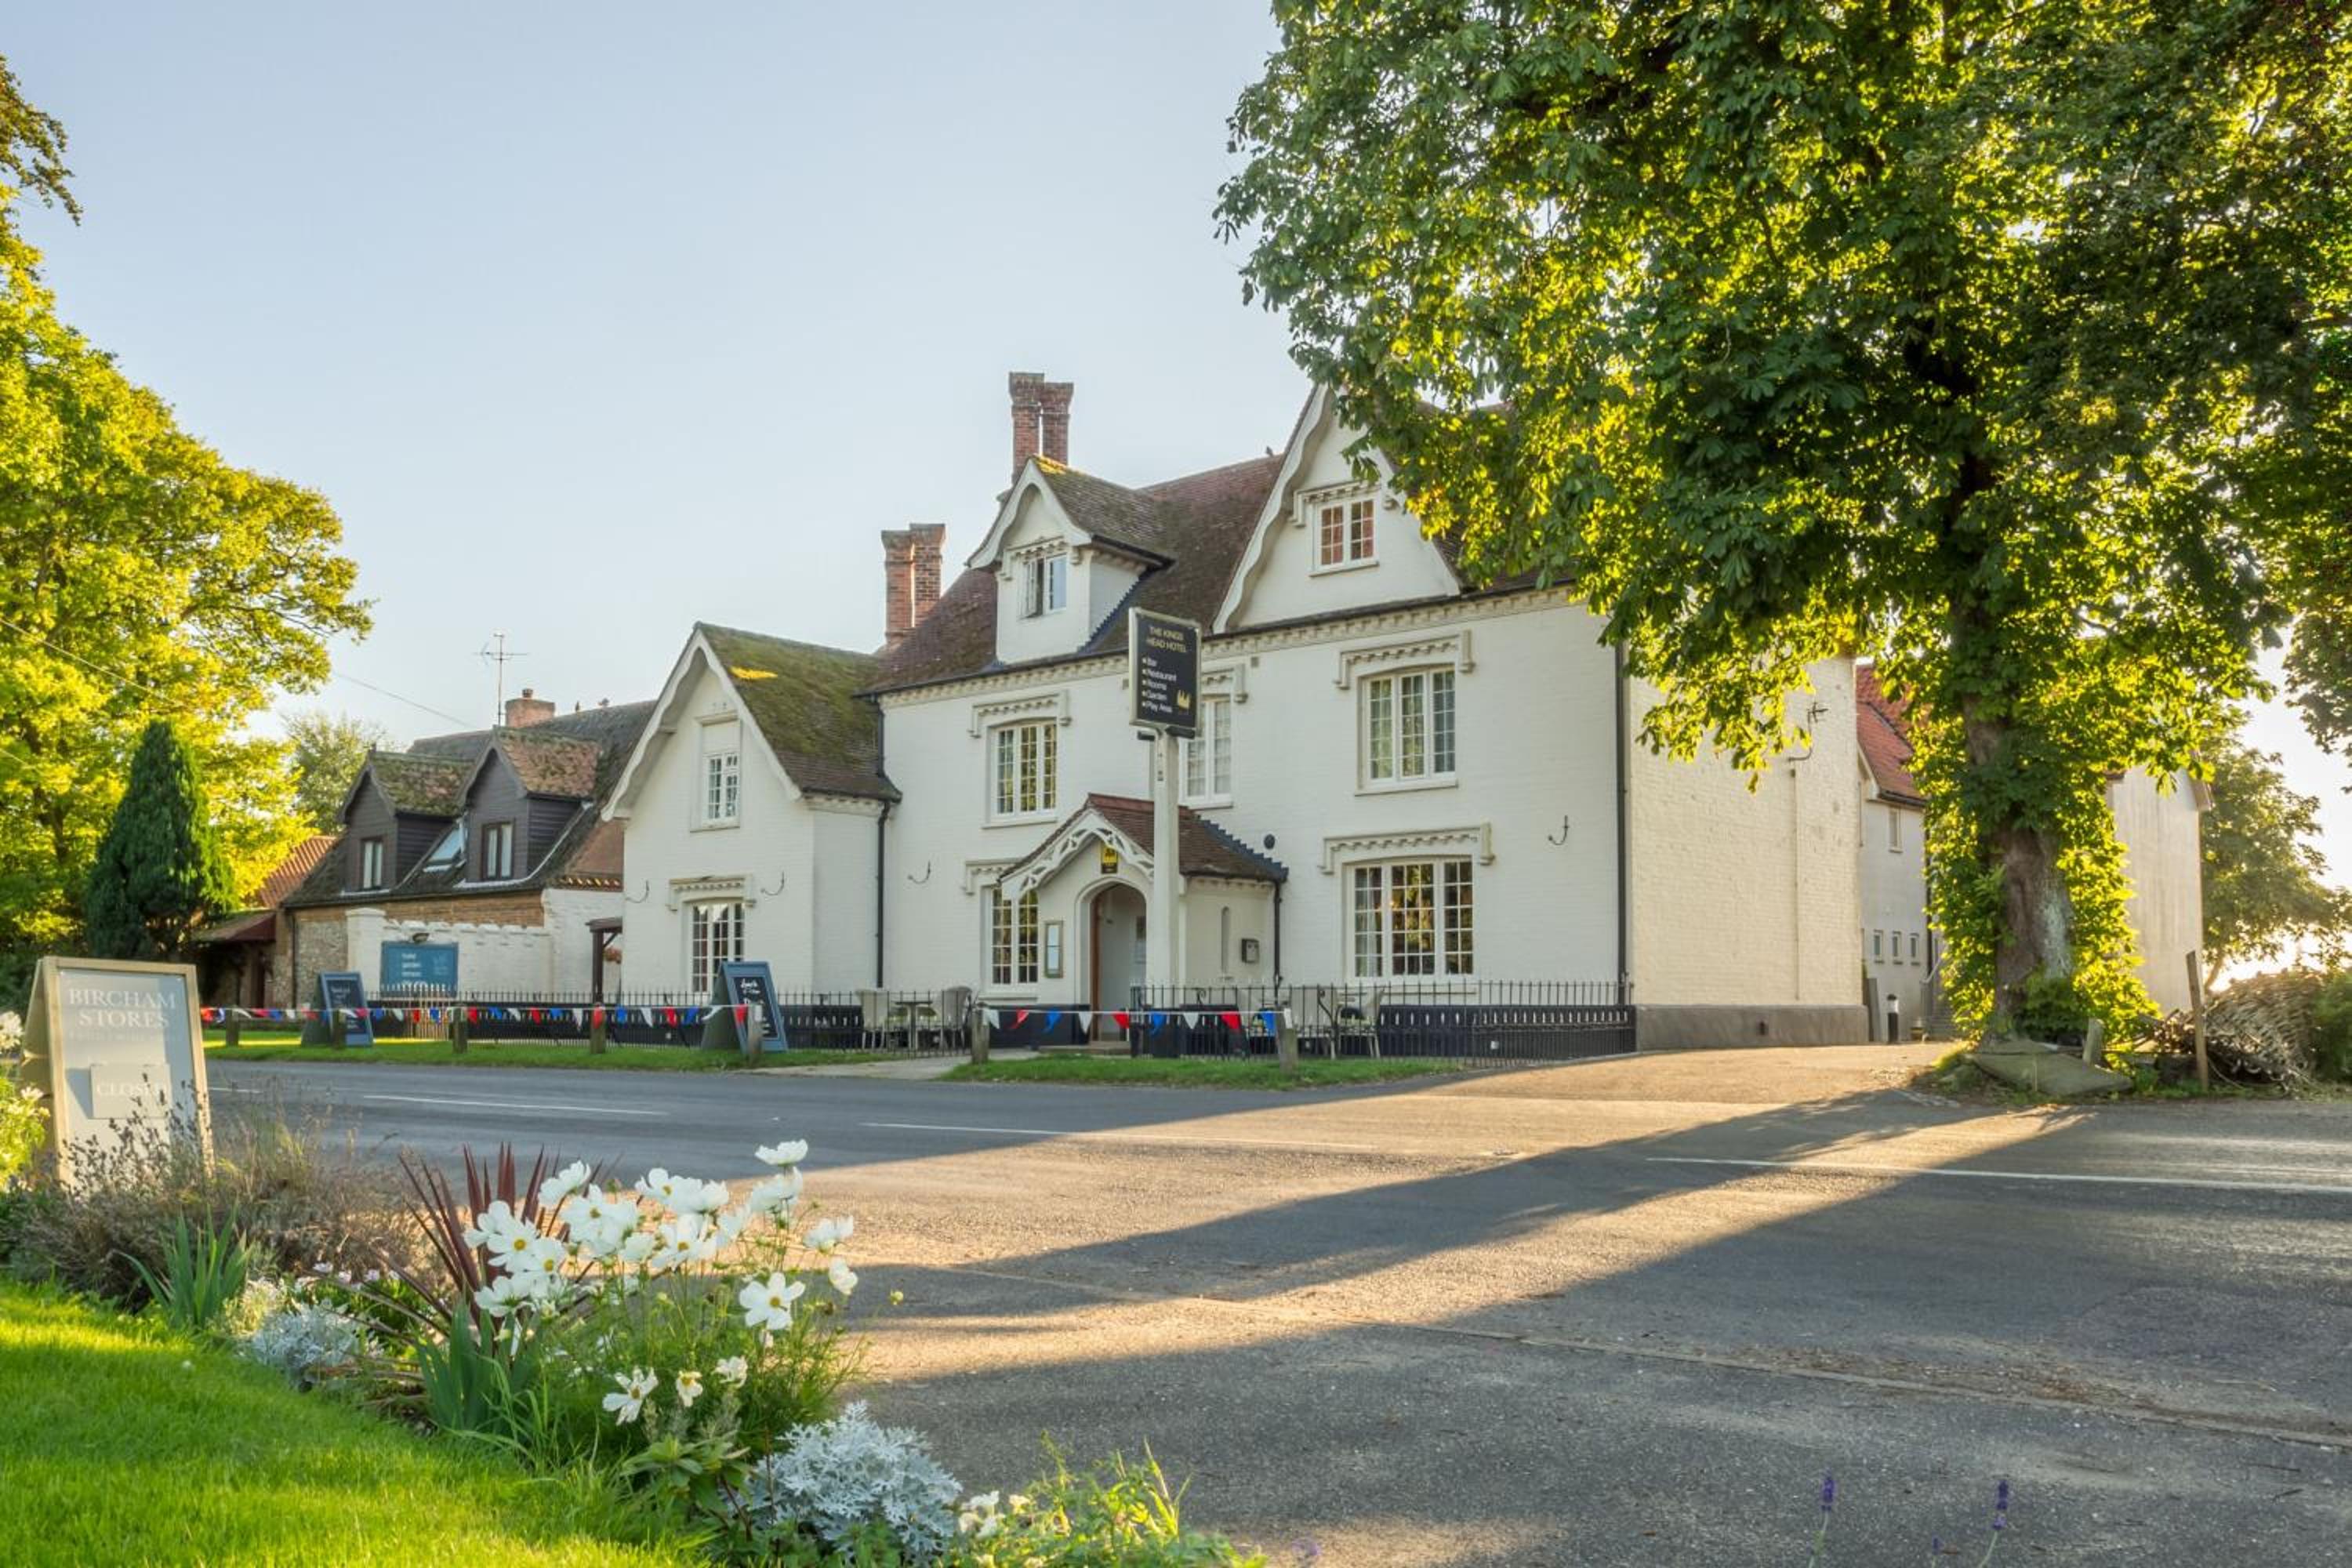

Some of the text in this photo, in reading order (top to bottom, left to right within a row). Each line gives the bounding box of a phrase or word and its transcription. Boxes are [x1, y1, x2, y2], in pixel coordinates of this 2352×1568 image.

[1146, 637, 1186, 653] HEAD HOTEL
[1148, 669, 1177, 682] Restaurant
[69, 989, 176, 1009] BIRCHAM
[78, 1009, 169, 1029] STORES
